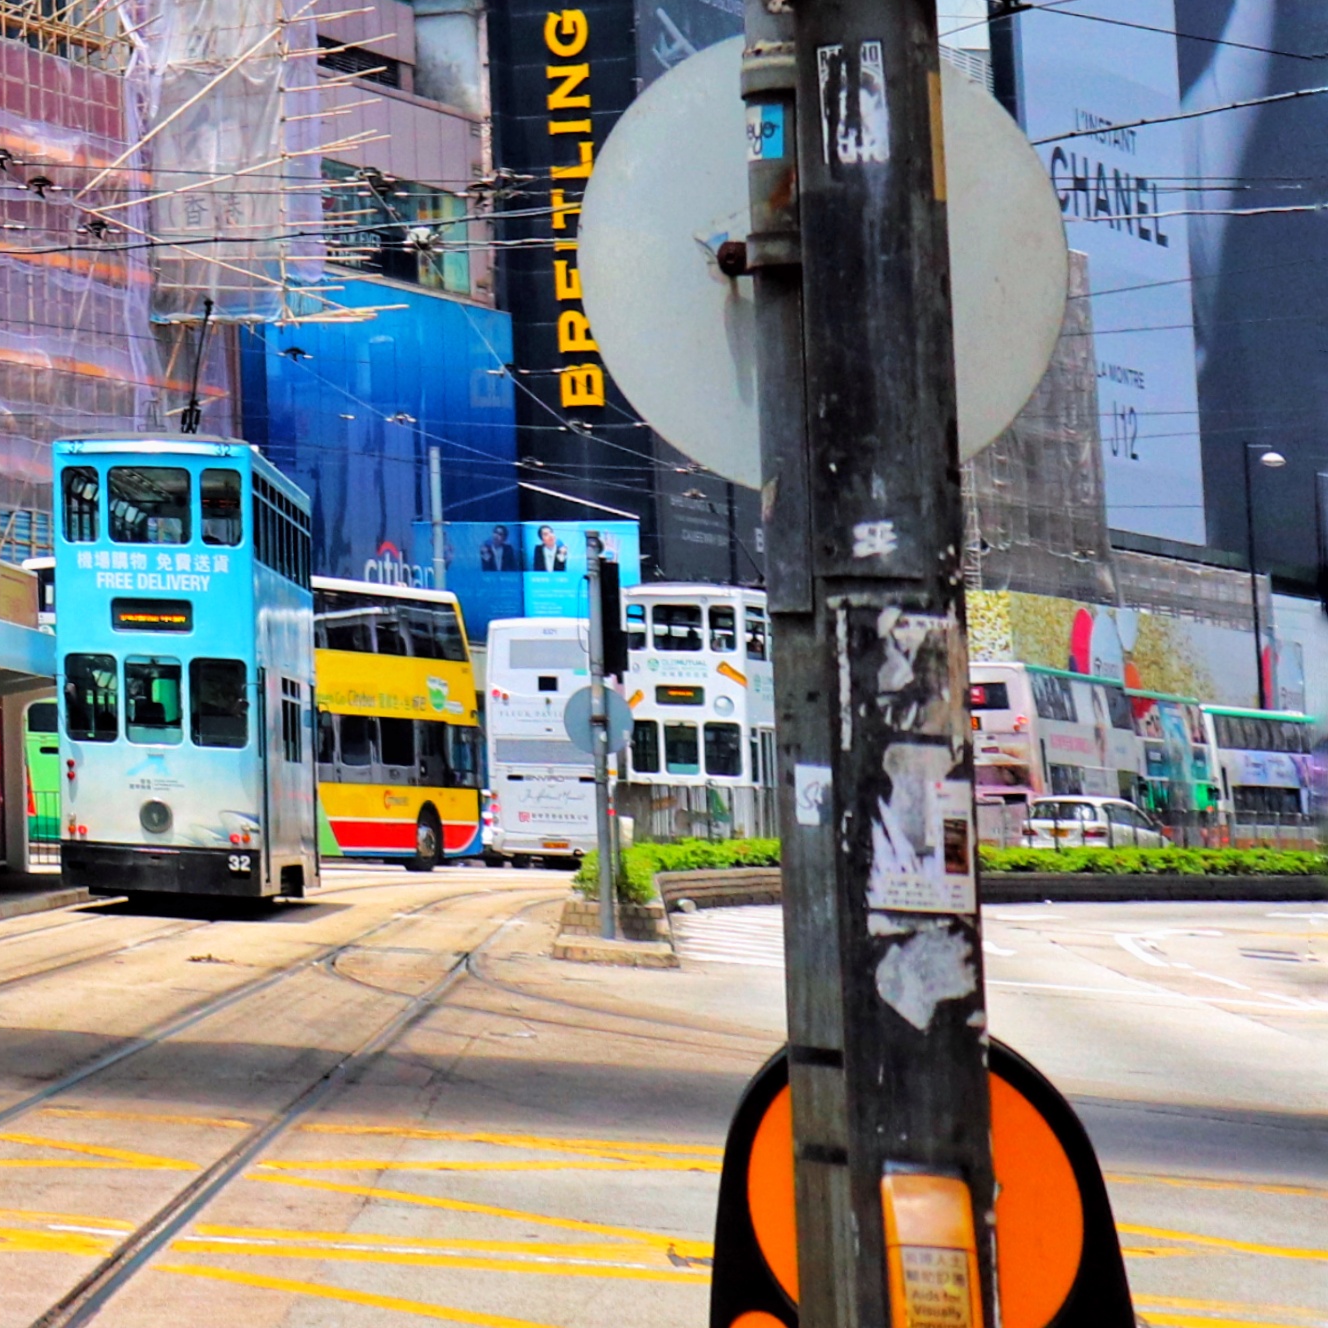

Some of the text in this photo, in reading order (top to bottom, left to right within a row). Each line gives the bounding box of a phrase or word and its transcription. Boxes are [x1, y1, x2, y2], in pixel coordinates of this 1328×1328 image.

[1074, 108, 1138, 156] L'INSTANT
[1051, 147, 1168, 248] CHANEL
[1111, 400, 1140, 460] J12
[97, 573, 210, 591] FREE DELIVERY
[228, 855, 251, 872] 32
